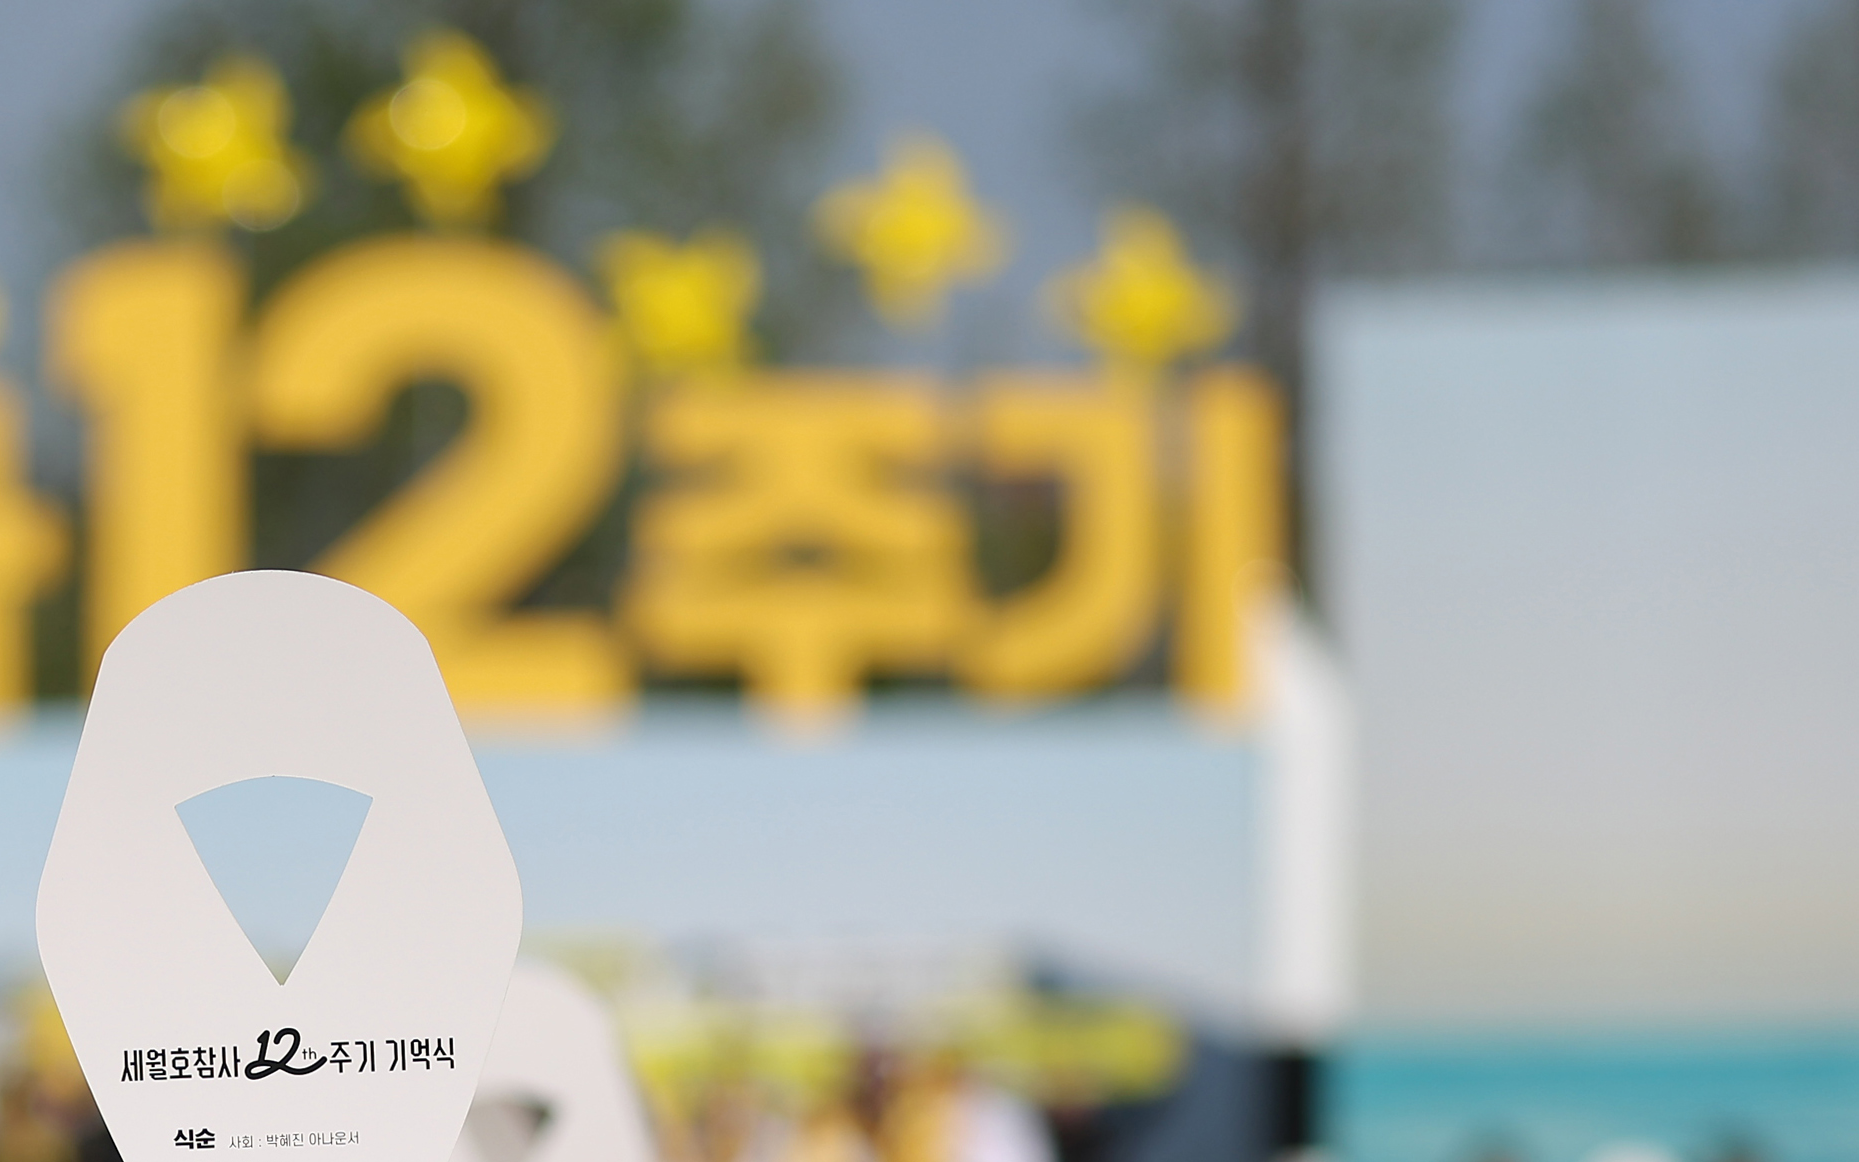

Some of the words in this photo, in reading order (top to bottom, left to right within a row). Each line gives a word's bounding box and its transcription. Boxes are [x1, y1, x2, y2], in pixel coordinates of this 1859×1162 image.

[120, 1045, 241, 1082] 세월호참사
[385, 1037, 456, 1071] 기억식
[172, 1127, 216, 1150] 식순
[228, 1134, 254, 1149] 사회
[266, 1133, 304, 1148] 박혜진
[308, 1130, 360, 1146] 아나운서
